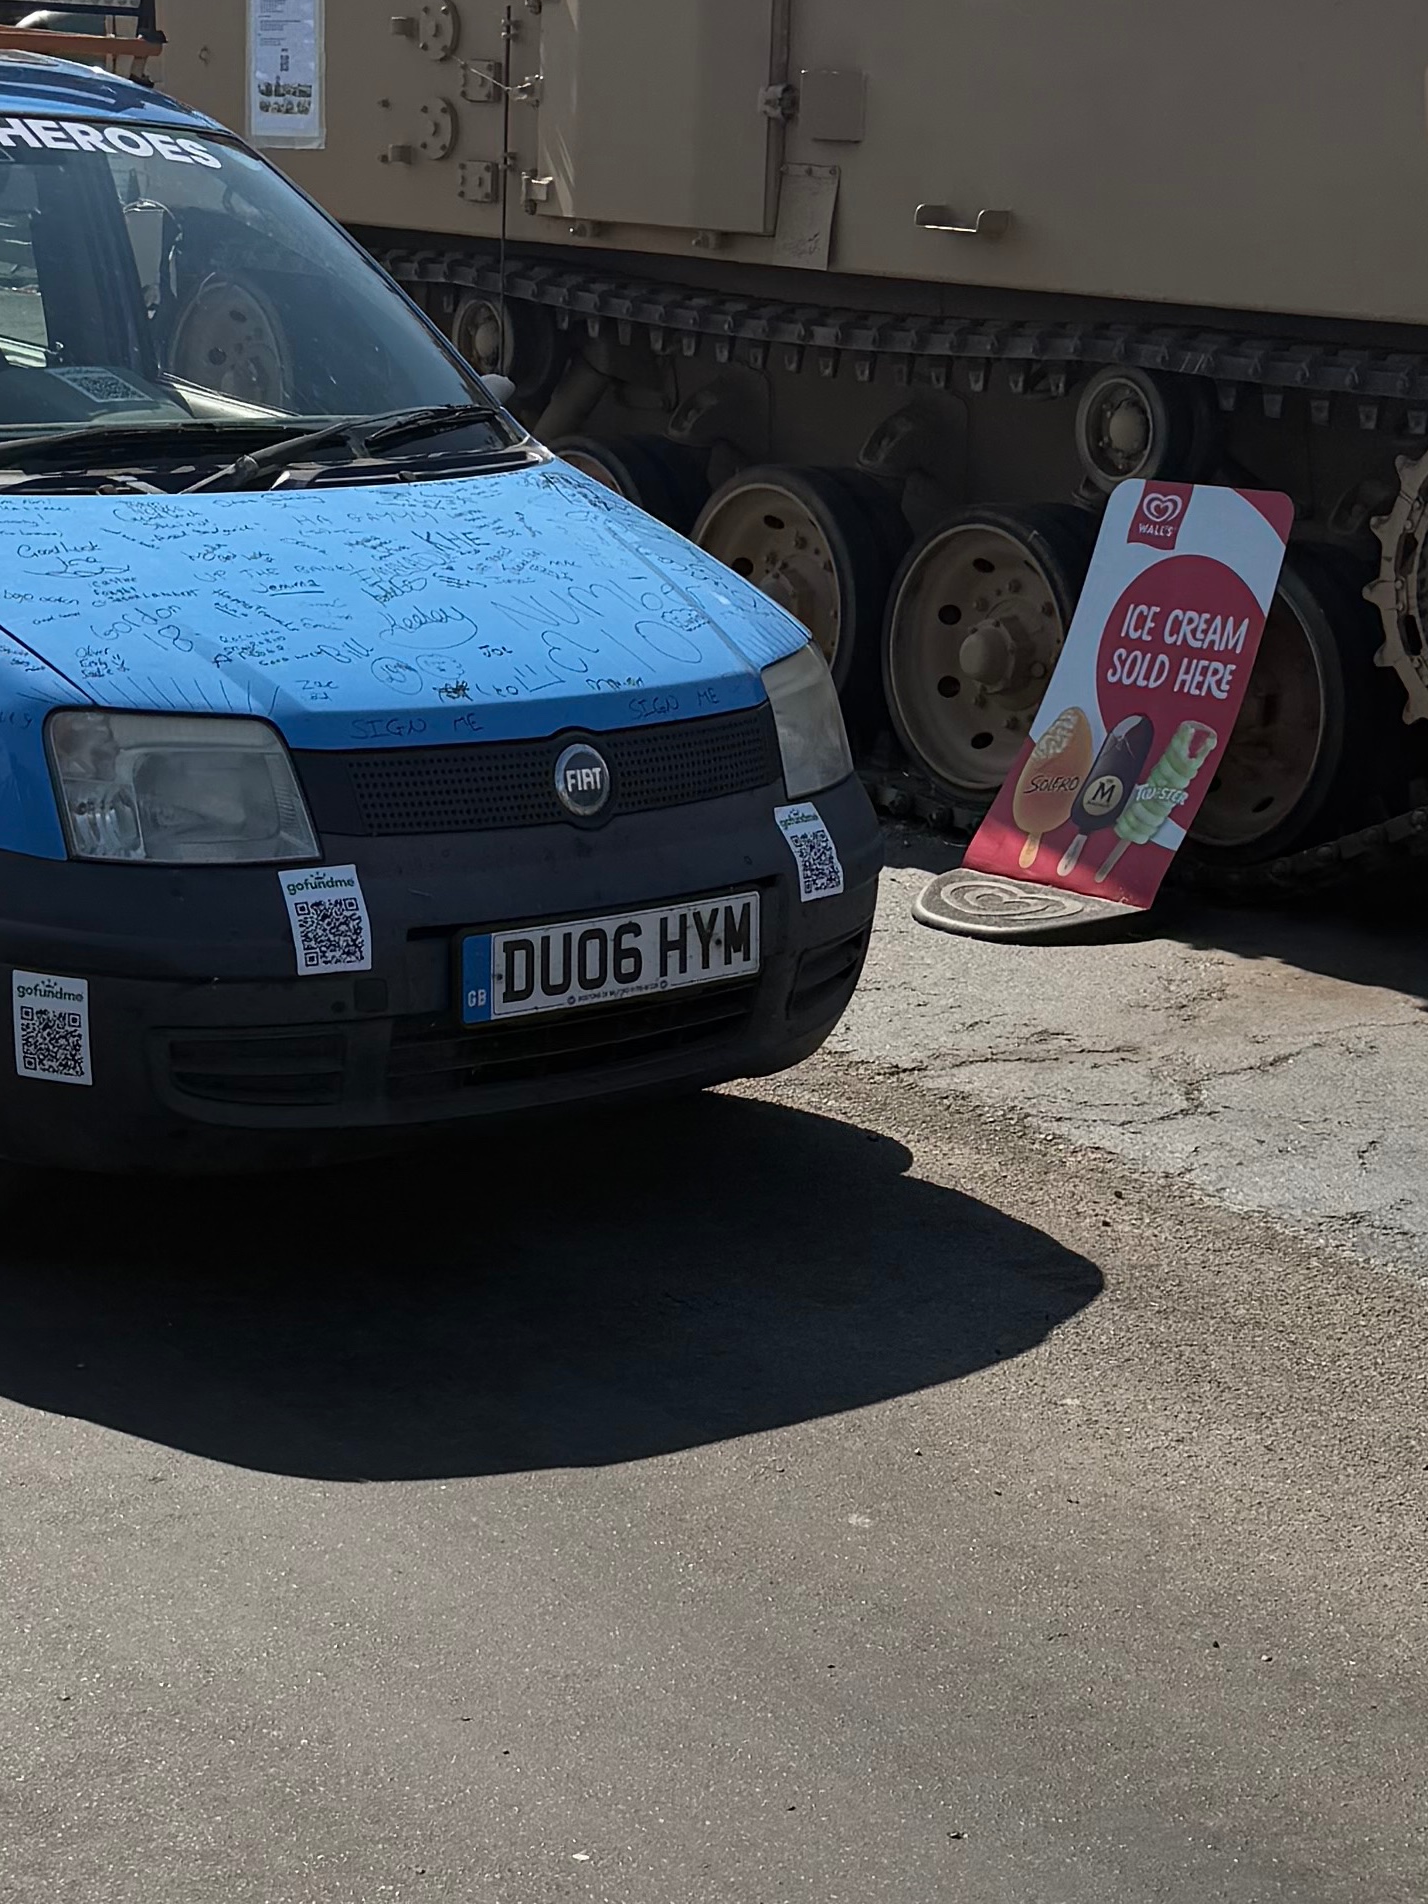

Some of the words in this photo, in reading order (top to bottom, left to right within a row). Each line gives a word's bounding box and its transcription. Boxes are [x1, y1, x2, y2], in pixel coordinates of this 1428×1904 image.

[1121, 604, 1160, 641] ICE
[1163, 609, 1249, 654] CREAM
[1107, 648, 1170, 688] SOLD
[1173, 657, 1236, 699] HERE
[629, 700, 680, 720] SIGN
[697, 687, 721, 708] ME
[351, 717, 428, 740] SIGN
[453, 712, 484, 732] ME
[566, 767, 601, 792] FIAT
[287, 876, 355, 896] gofundme
[502, 921, 643, 1004] DU06
[659, 901, 751, 978] HYM
[16, 982, 84, 1002] gofundme
[467, 988, 487, 1007] GB
